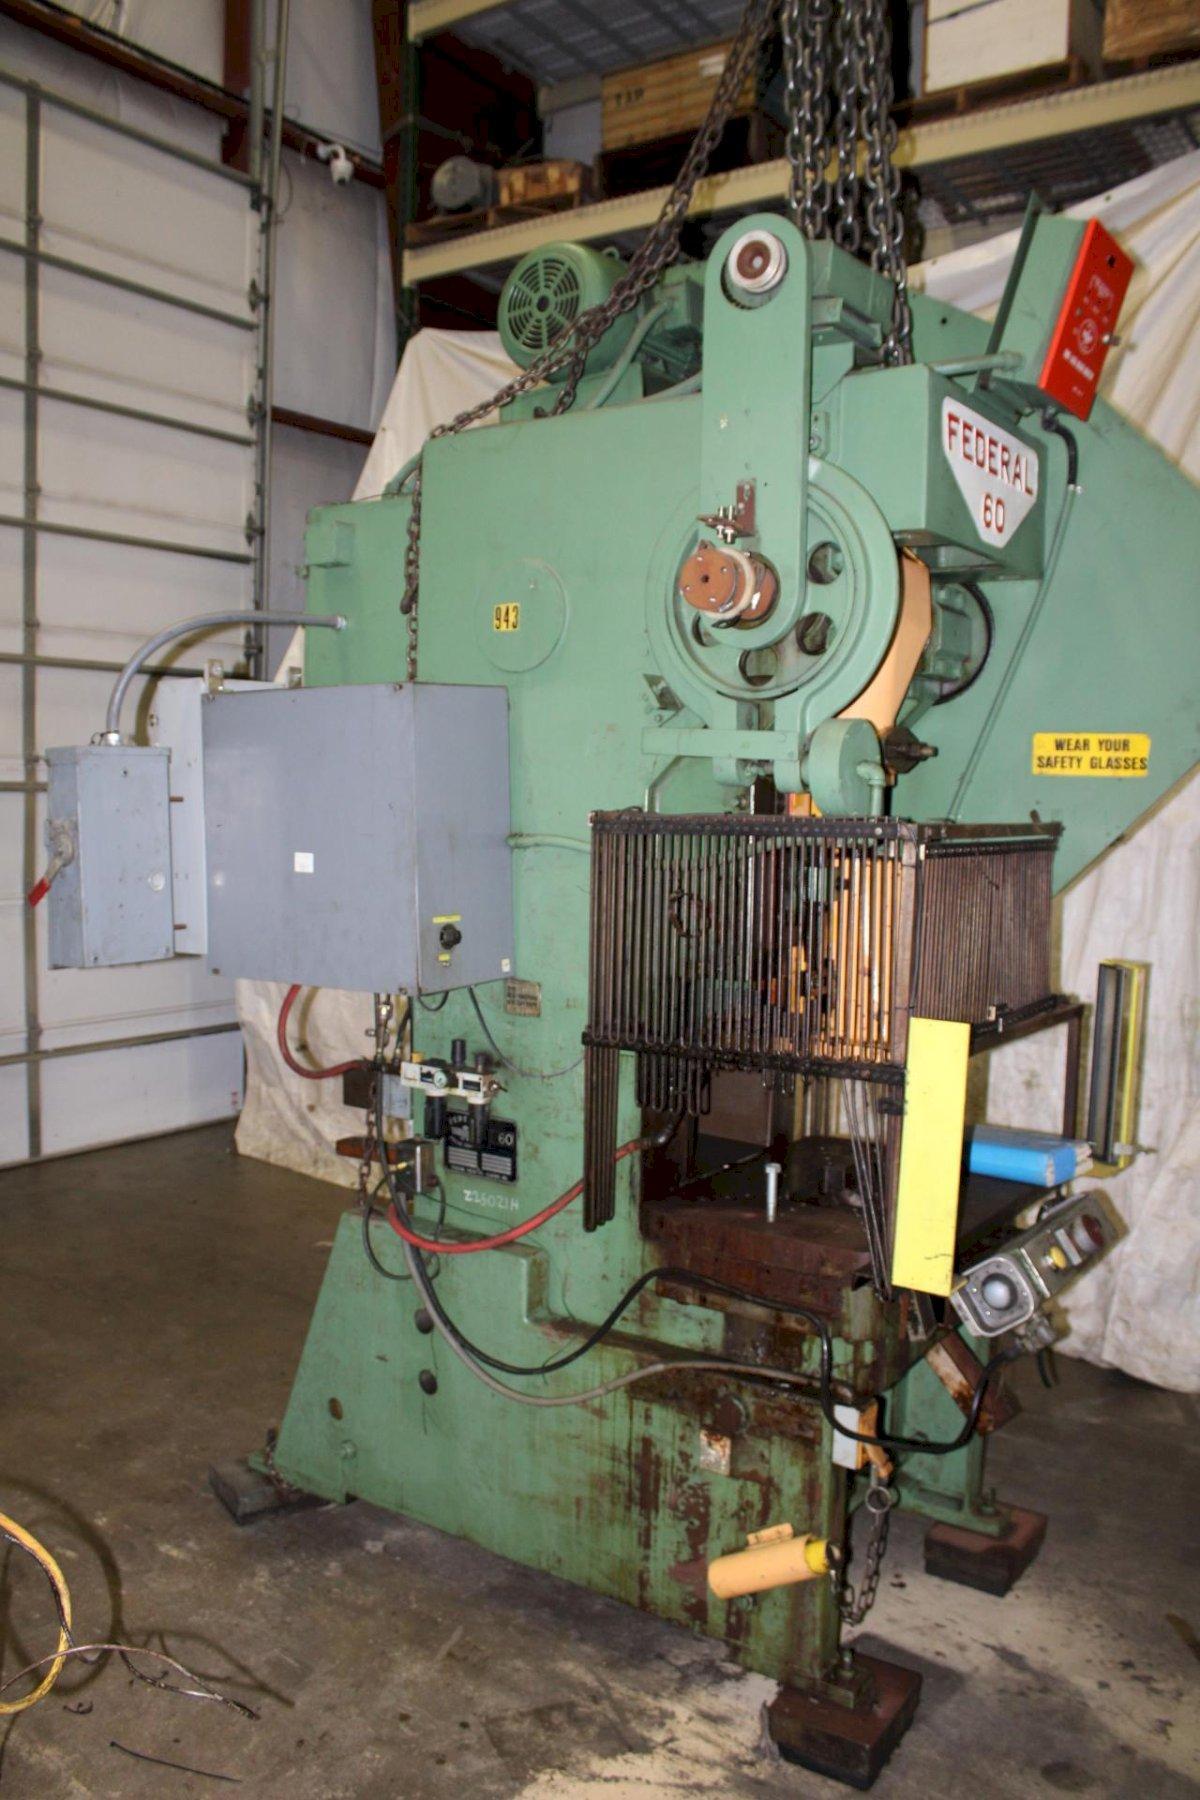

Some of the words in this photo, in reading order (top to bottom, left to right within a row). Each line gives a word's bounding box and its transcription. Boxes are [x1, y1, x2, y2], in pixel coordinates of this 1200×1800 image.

[947, 412, 1034, 496] FEDERAL
[983, 493, 1005, 534] 60
[495, 605, 518, 630] 943
[1055, 739, 1090, 751] WEAR
[1098, 739, 1130, 752] YOUR
[1037, 756, 1083, 769] SAFETY
[1090, 757, 1148, 770] GLASSES
[498, 1132, 514, 1146] 60
